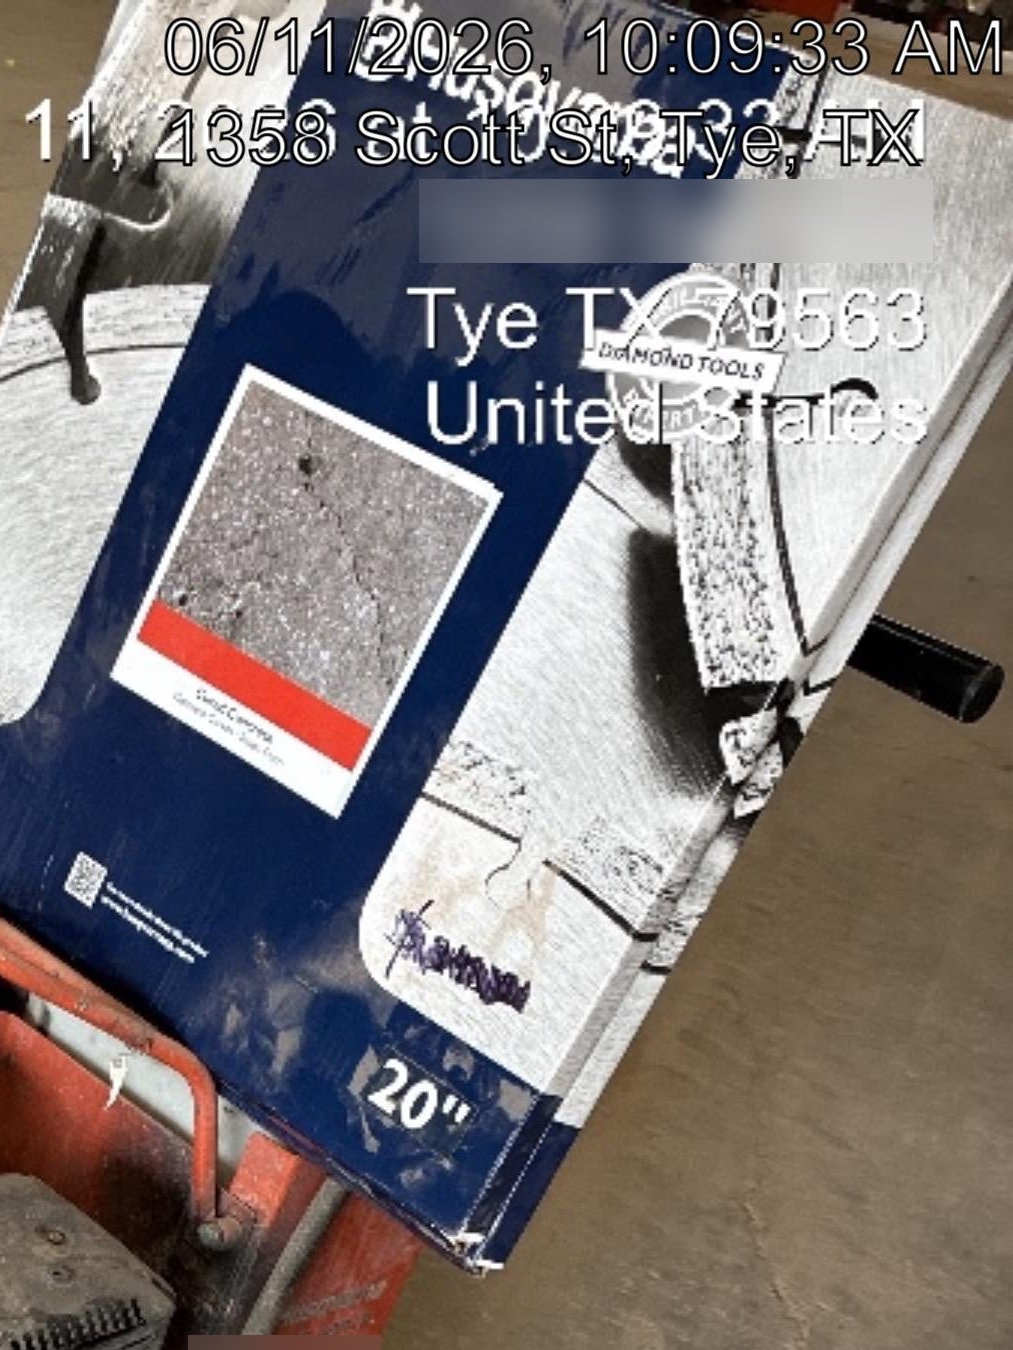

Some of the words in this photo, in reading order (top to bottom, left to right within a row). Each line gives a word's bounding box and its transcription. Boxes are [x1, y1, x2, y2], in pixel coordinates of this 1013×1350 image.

[597, 340, 694, 371] DIAMOND
[698, 355, 767, 381] TOOLS
[367, 1058, 472, 1129] 20"
